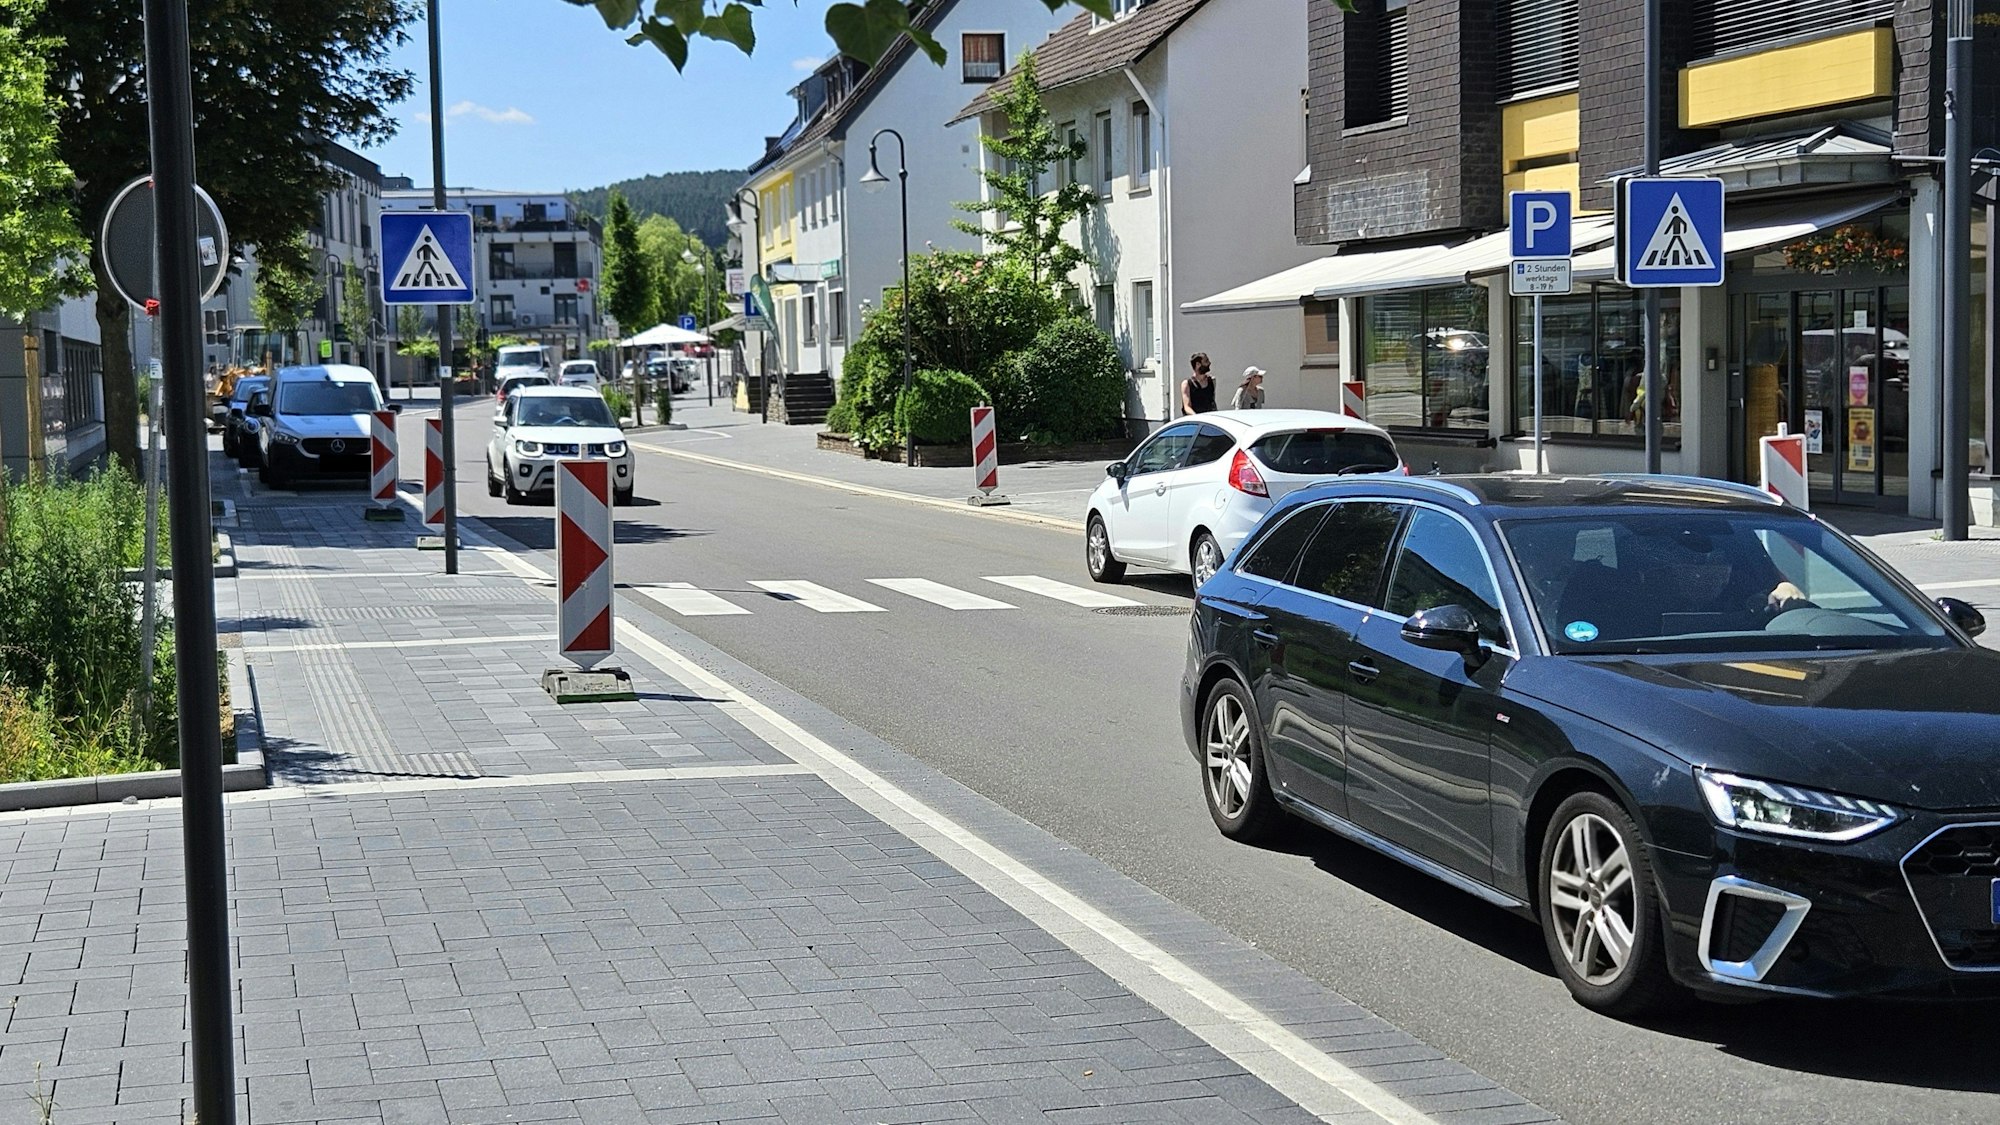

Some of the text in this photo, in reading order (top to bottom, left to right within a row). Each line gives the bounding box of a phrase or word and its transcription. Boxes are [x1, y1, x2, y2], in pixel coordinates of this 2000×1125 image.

[1526, 200, 1557, 249] P
[1527, 264, 1566, 273] 2 Stunden
[1525, 275, 1558, 283] werktags
[684, 318, 693, 329] P
